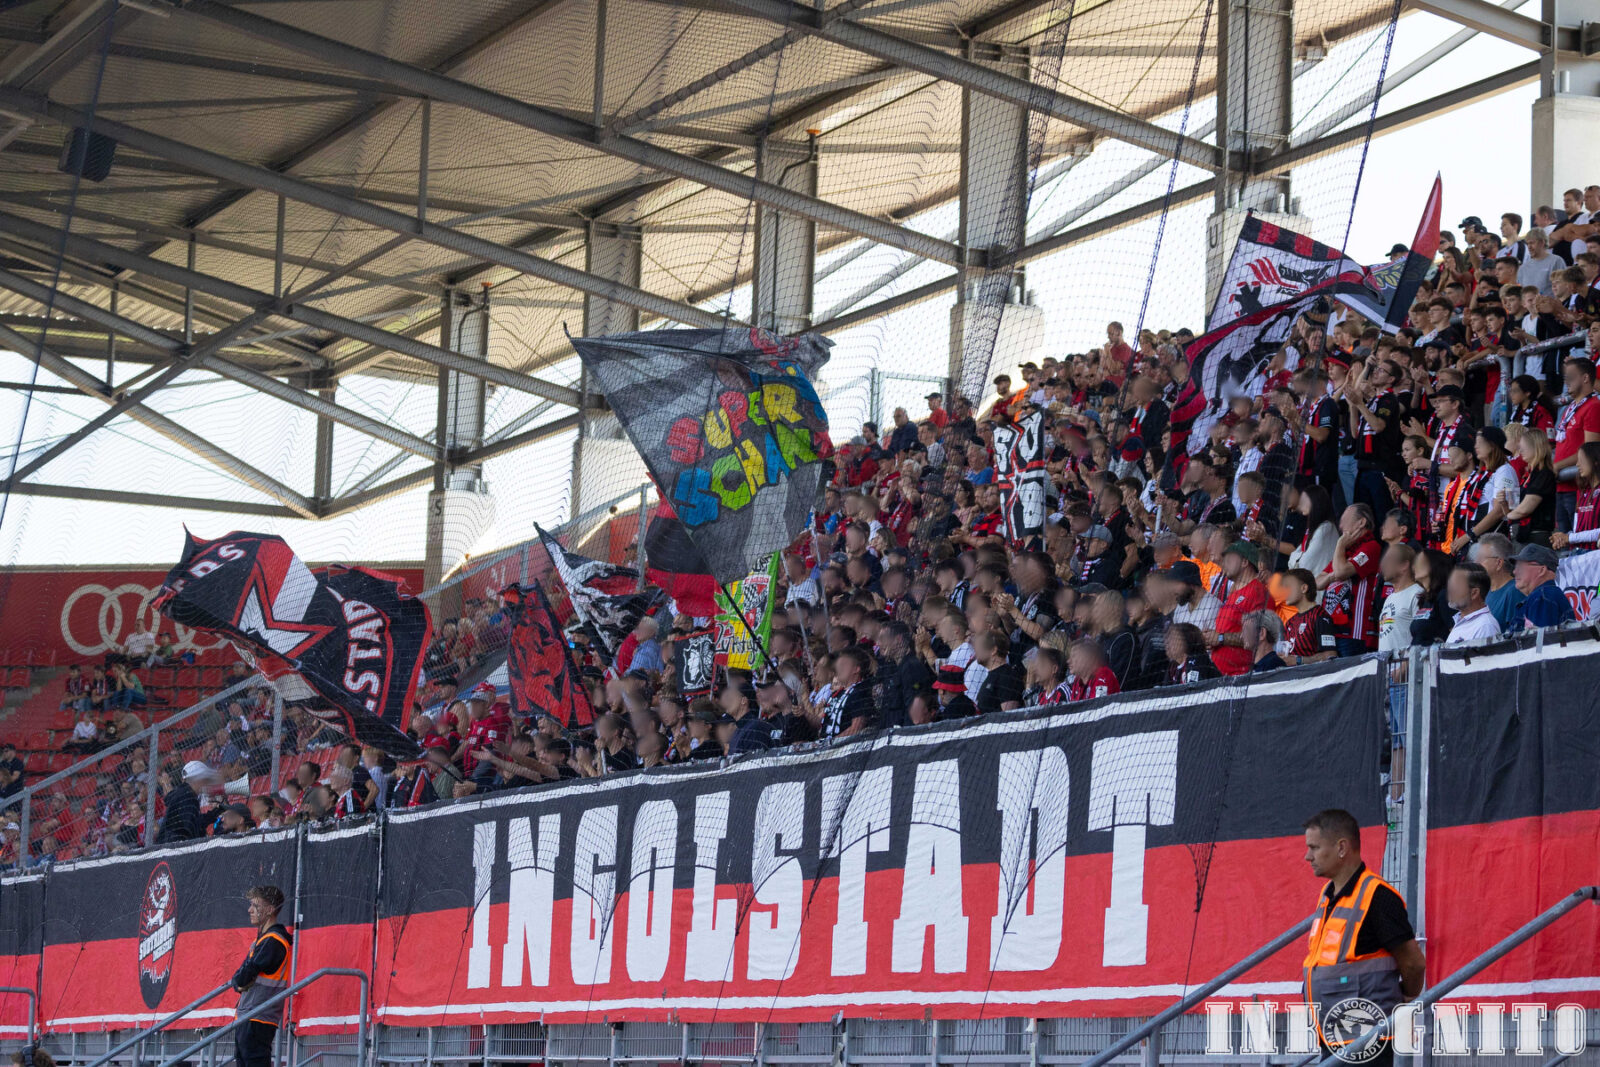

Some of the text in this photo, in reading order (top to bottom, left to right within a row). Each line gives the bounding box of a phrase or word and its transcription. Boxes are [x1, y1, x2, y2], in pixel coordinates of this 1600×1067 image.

[666, 383, 804, 465] SUPER
[332, 588, 385, 712] STAD
[466, 729, 1180, 990] INGOLSTADT
